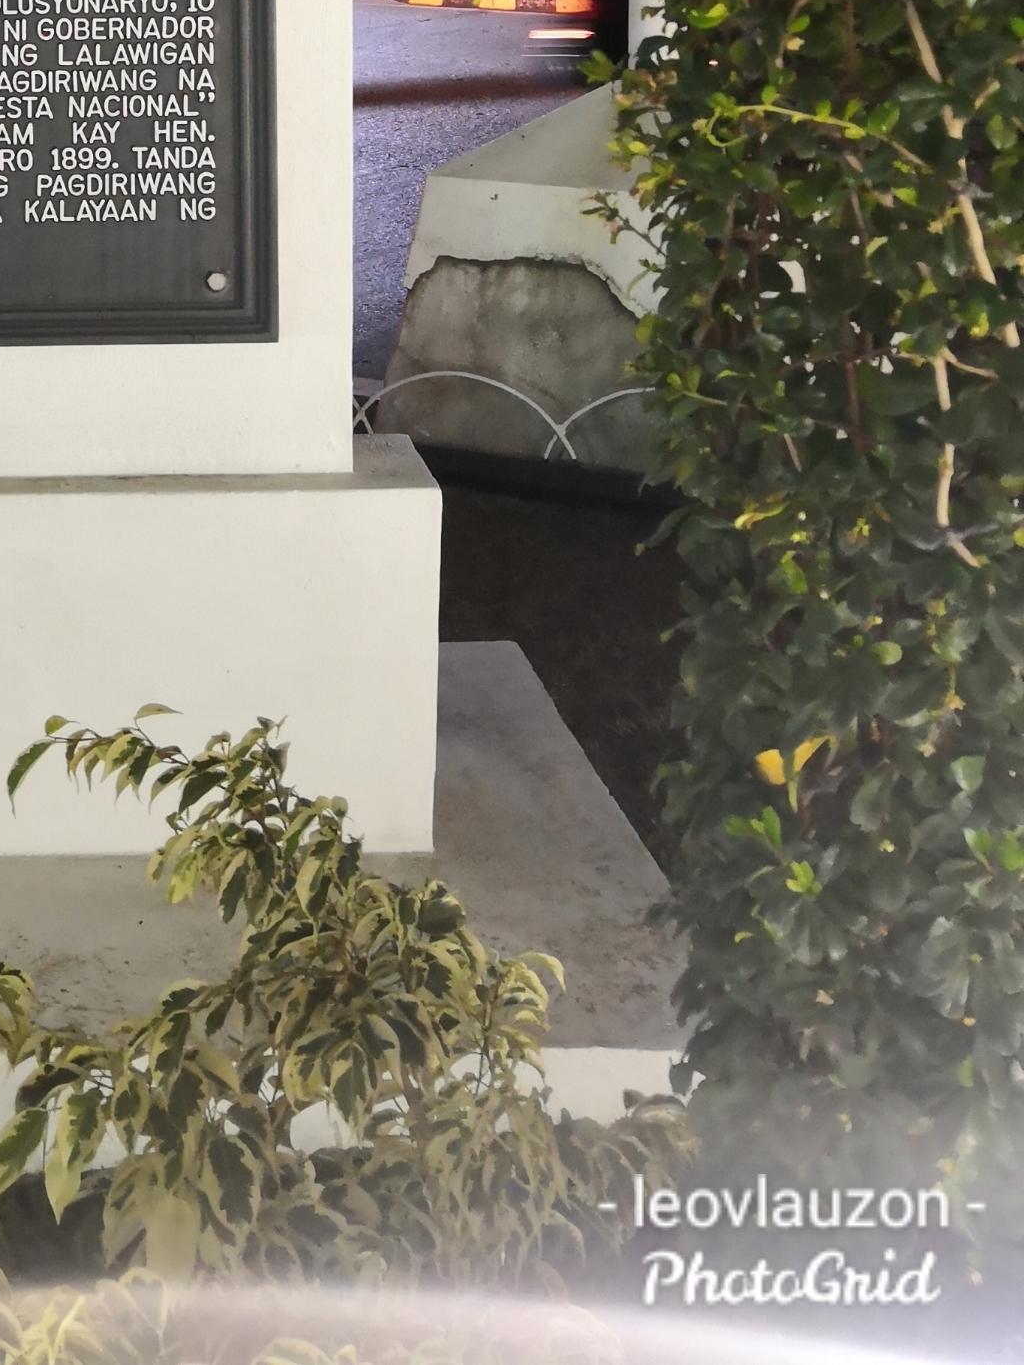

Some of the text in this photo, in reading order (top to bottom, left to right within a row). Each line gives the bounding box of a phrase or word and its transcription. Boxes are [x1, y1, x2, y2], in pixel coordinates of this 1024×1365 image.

[3, 18, 27, 42] NI
[37, 15, 215, 41] GOBERNADOR
[1, 43, 38, 67] NG
[58, 41, 215, 66] LALAWIGAN
[178, 68, 216, 91] NA
[72, 120, 121, 145] KAY
[154, 119, 216, 143] HEN.
[51, 146, 119, 171] 1899.
[131, 145, 217, 170] TANDA
[36, 171, 216, 197] PAGDIRIWANG
[24, 198, 157, 223] KALAYAAN
[180, 197, 217, 221] NG
